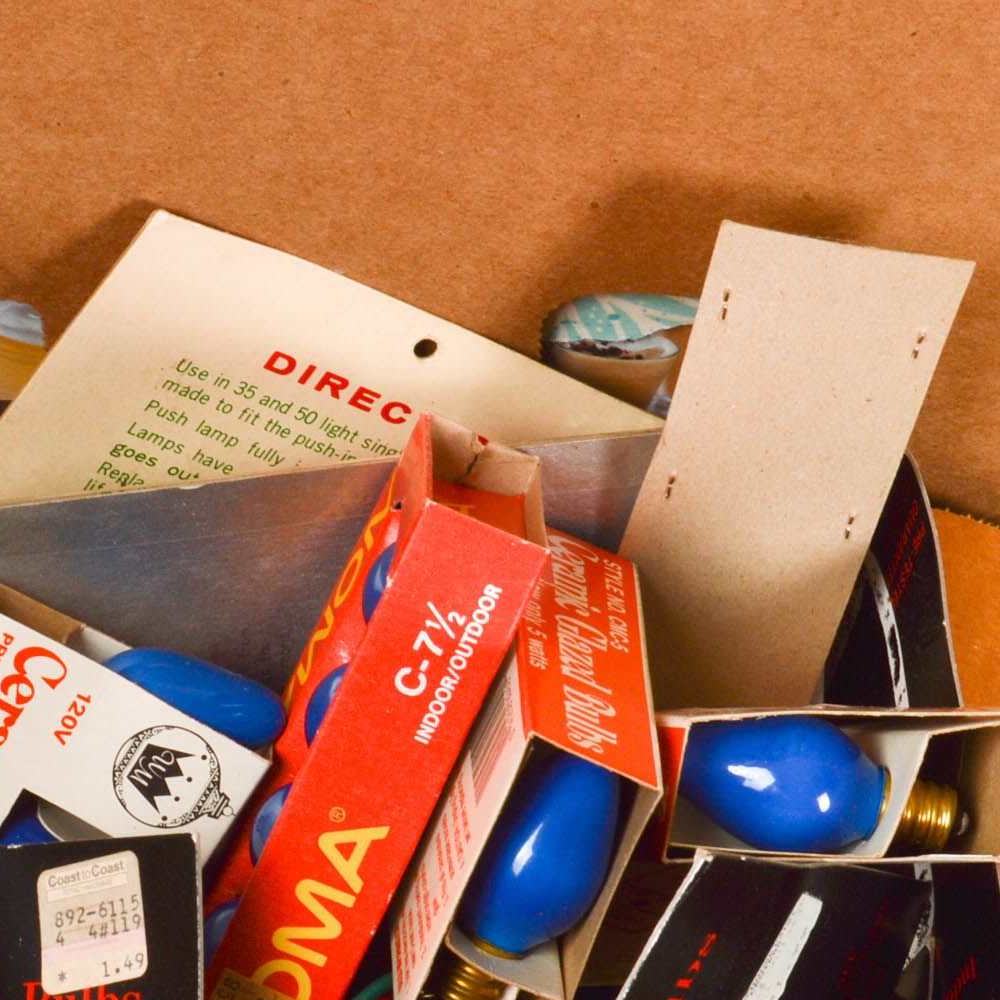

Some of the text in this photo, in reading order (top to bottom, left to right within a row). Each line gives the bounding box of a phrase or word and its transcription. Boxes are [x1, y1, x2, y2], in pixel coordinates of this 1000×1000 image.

[162, 378, 210, 405] made
[216, 399, 233, 414] to
[238, 407, 261, 427] fit
[264, 418, 291, 438] the
[176, 358, 209, 381] Use
[213, 372, 231, 390] in
[234, 381, 257, 400] 35
[259, 391, 294, 415] and
[294, 406, 318, 425] 50
[319, 416, 358, 444] light
[109, 442, 159, 468] goes
[127, 421, 234, 476] Lamps have
[144, 399, 285, 468] Push lamp fully
[414, 584, 503, 744] INDOOR/OUTDOOR
[53, 694, 91, 746] 120V
[48, 870, 81, 888] Coast
[91, 860, 124, 878] Coast
[55, 894, 140, 928] 892-6115
[56, 932, 65, 946] 4
[101, 953, 145, 978] 1.49
